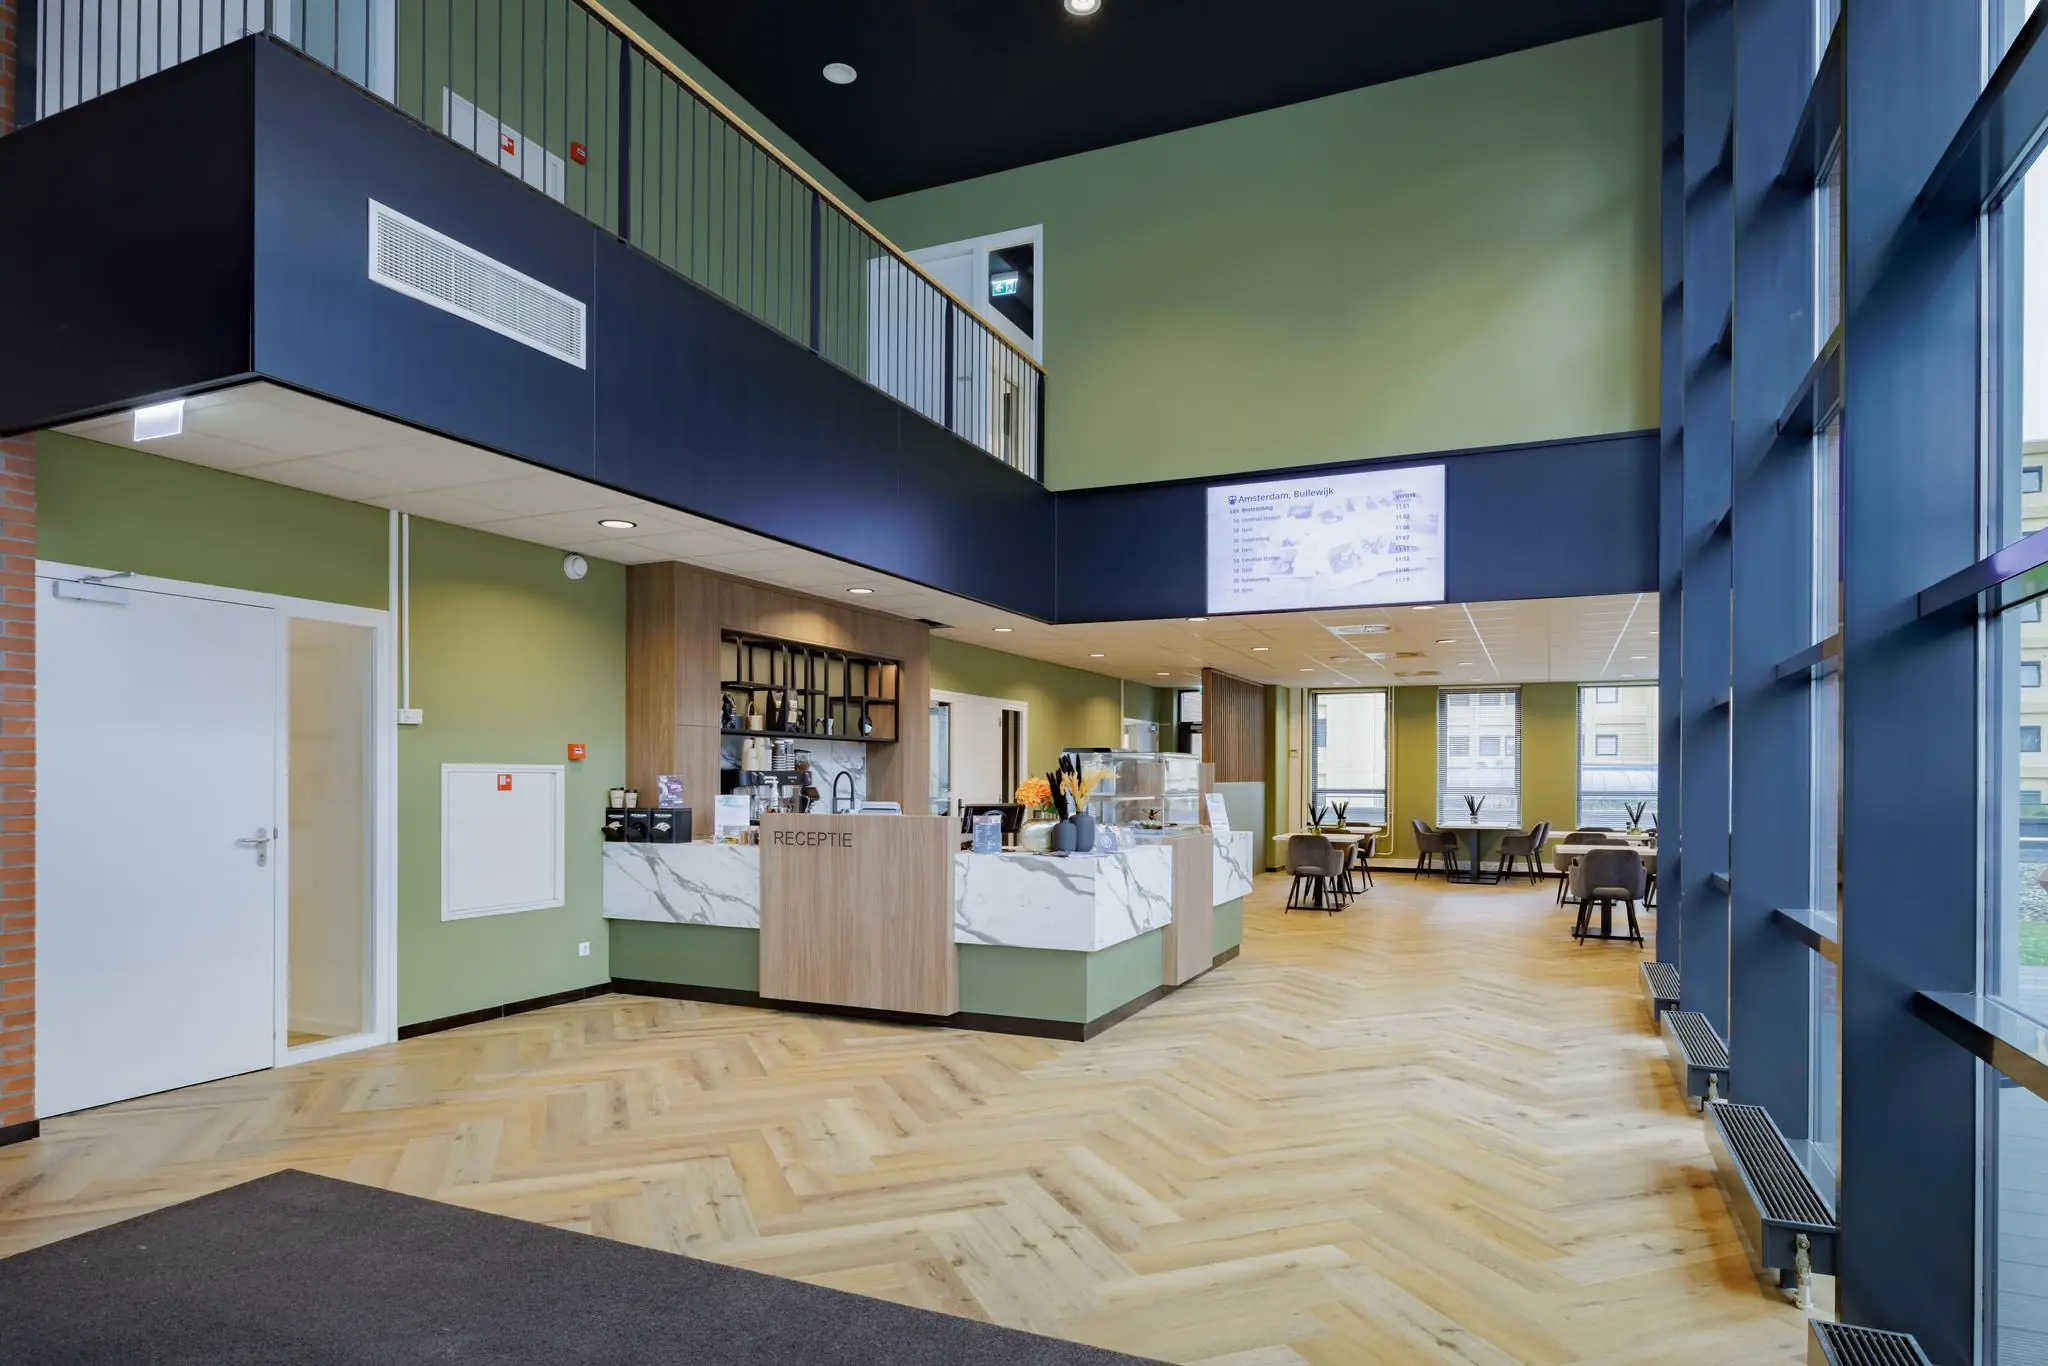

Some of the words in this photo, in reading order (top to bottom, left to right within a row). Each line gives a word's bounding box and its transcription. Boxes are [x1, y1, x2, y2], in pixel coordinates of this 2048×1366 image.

[1238, 492, 1291, 503] Amsterdam,
[1293, 487, 1334, 498] Bullewijk
[773, 831, 853, 847] RECEPTIE
